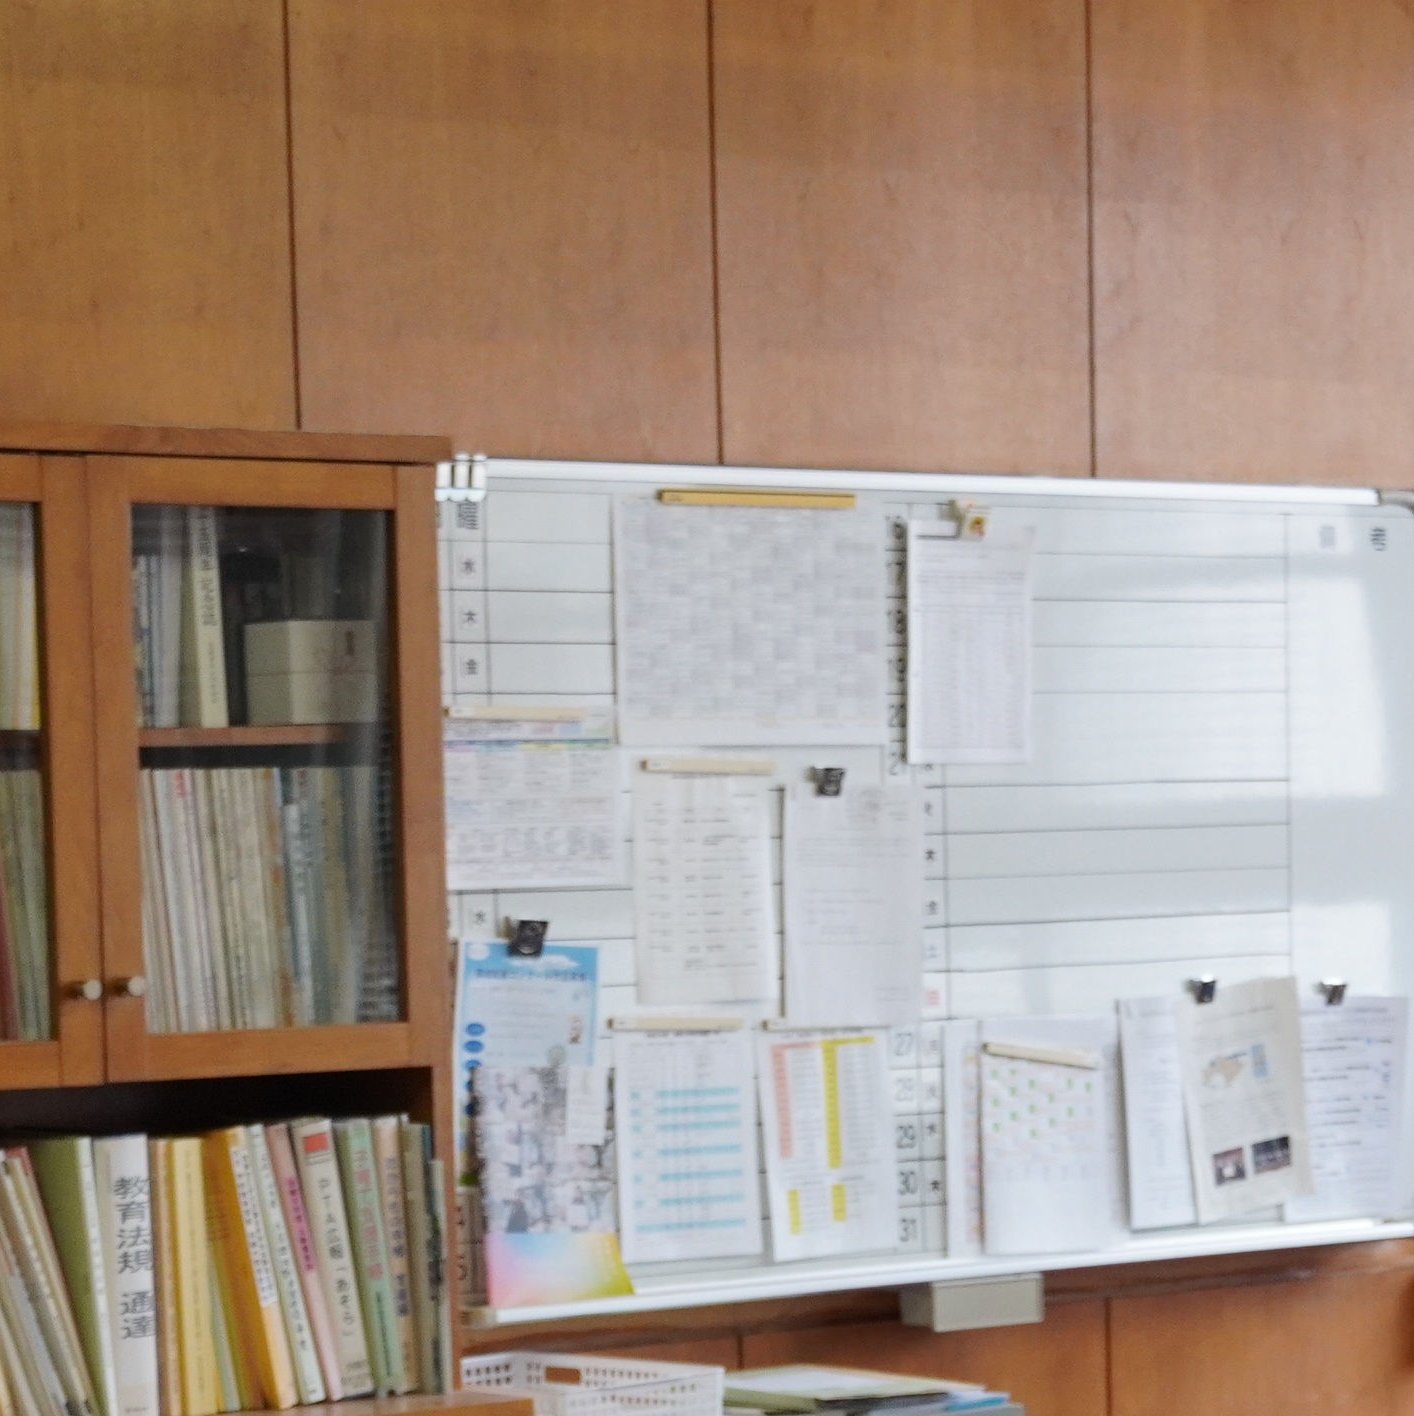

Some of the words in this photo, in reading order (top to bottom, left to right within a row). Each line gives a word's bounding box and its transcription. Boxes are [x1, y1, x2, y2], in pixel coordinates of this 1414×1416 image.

[898, 1170, 918, 1196] 30
[113, 1176, 153, 1275] 教育法規
[119, 1291, 155, 1341] 通達
